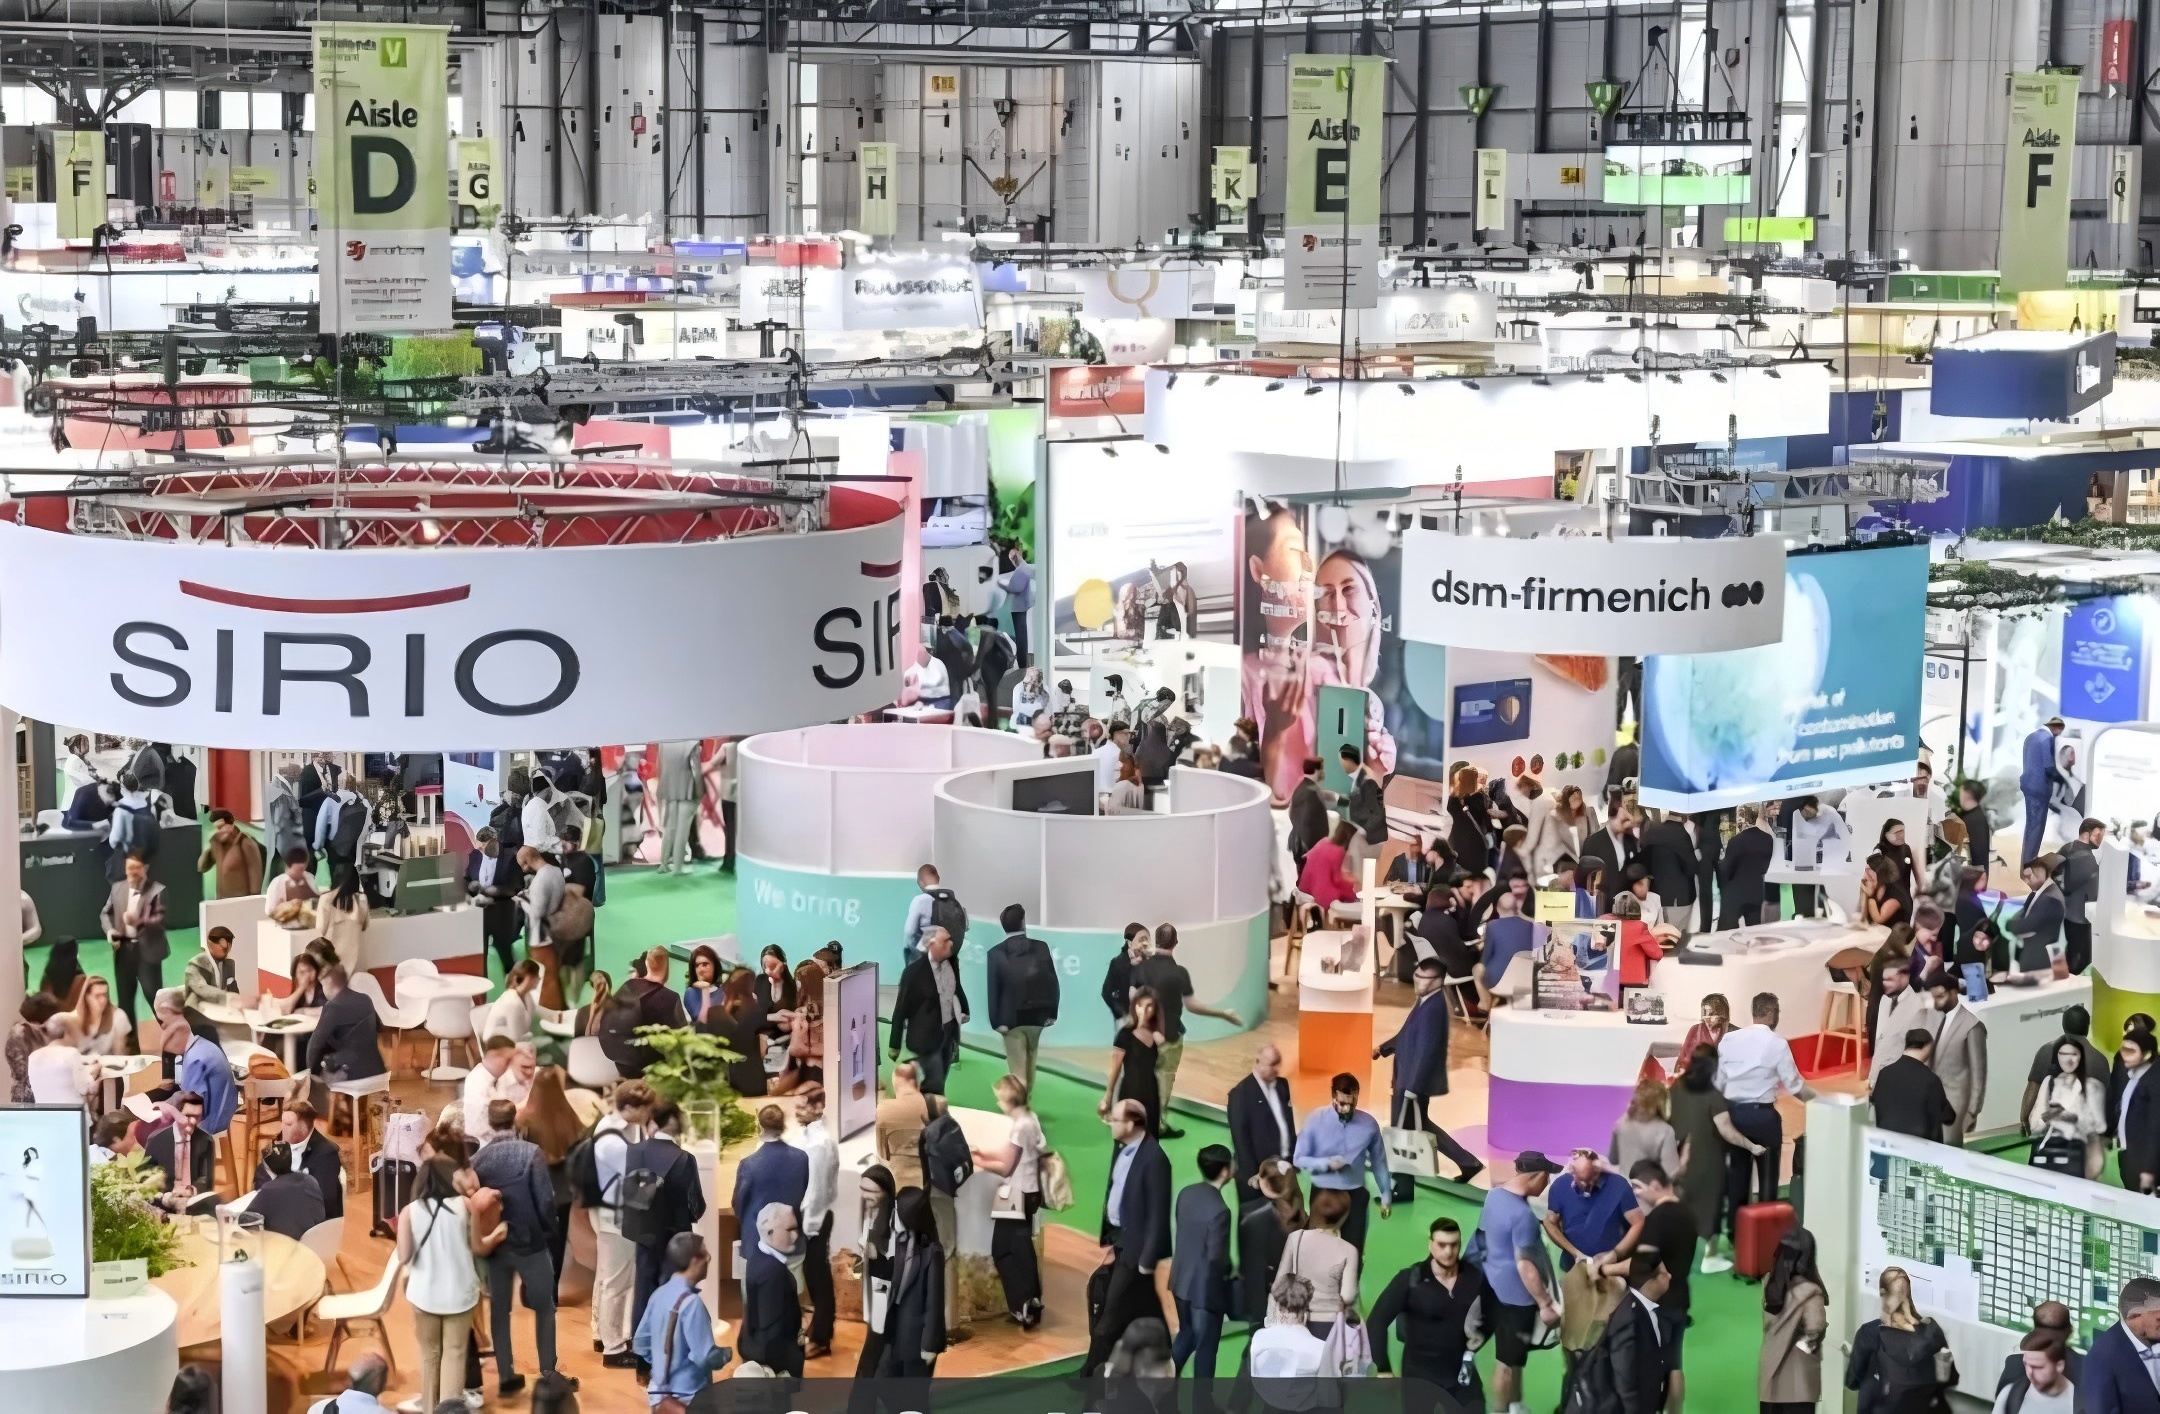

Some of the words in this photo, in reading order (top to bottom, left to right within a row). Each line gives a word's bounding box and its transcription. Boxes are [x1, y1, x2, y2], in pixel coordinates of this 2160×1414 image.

[345, 98, 418, 128] Aisle
[73, 169, 90, 196] F
[350, 134, 417, 215] D
[469, 173, 489, 199] G
[867, 175, 887, 199] H
[1225, 177, 1241, 199] K
[1314, 148, 1350, 212] E
[1486, 179, 1497, 199] L
[2027, 152, 2054, 208] F
[1432, 570, 1711, 613] dsm-firmenich
[110, 621, 581, 717] SIRIO
